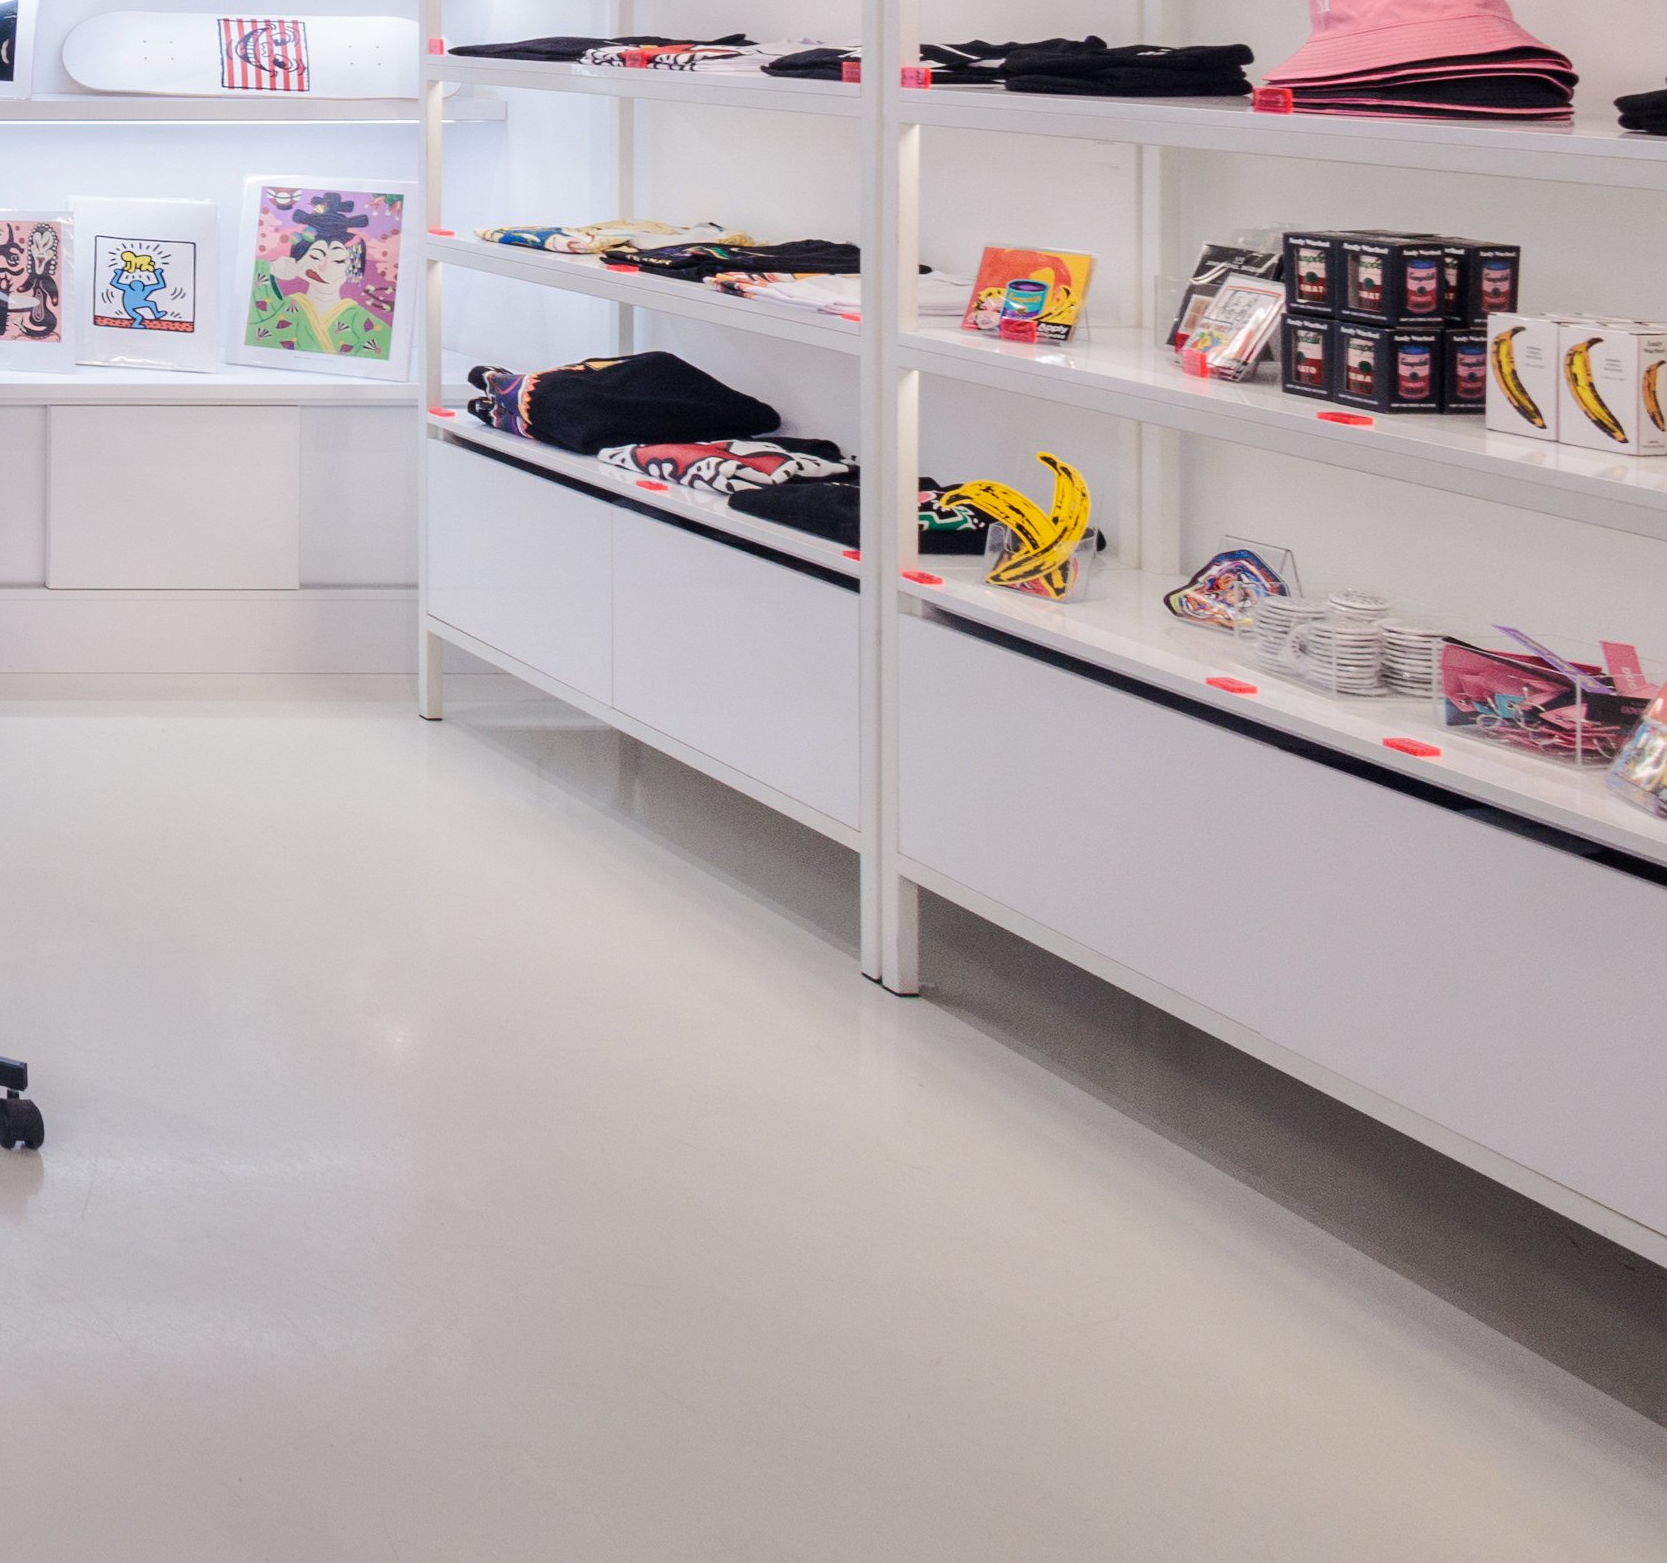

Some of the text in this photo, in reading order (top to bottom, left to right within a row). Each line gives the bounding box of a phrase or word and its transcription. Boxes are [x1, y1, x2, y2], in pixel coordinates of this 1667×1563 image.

[1288, 237, 1331, 248] Andy Warhol
[1342, 243, 1389, 255] Andy Warhol
[1038, 322, 1069, 335] Apply
[1287, 318, 1328, 330] Andy Warhol
[1340, 326, 1380, 339] Andy Warhol
